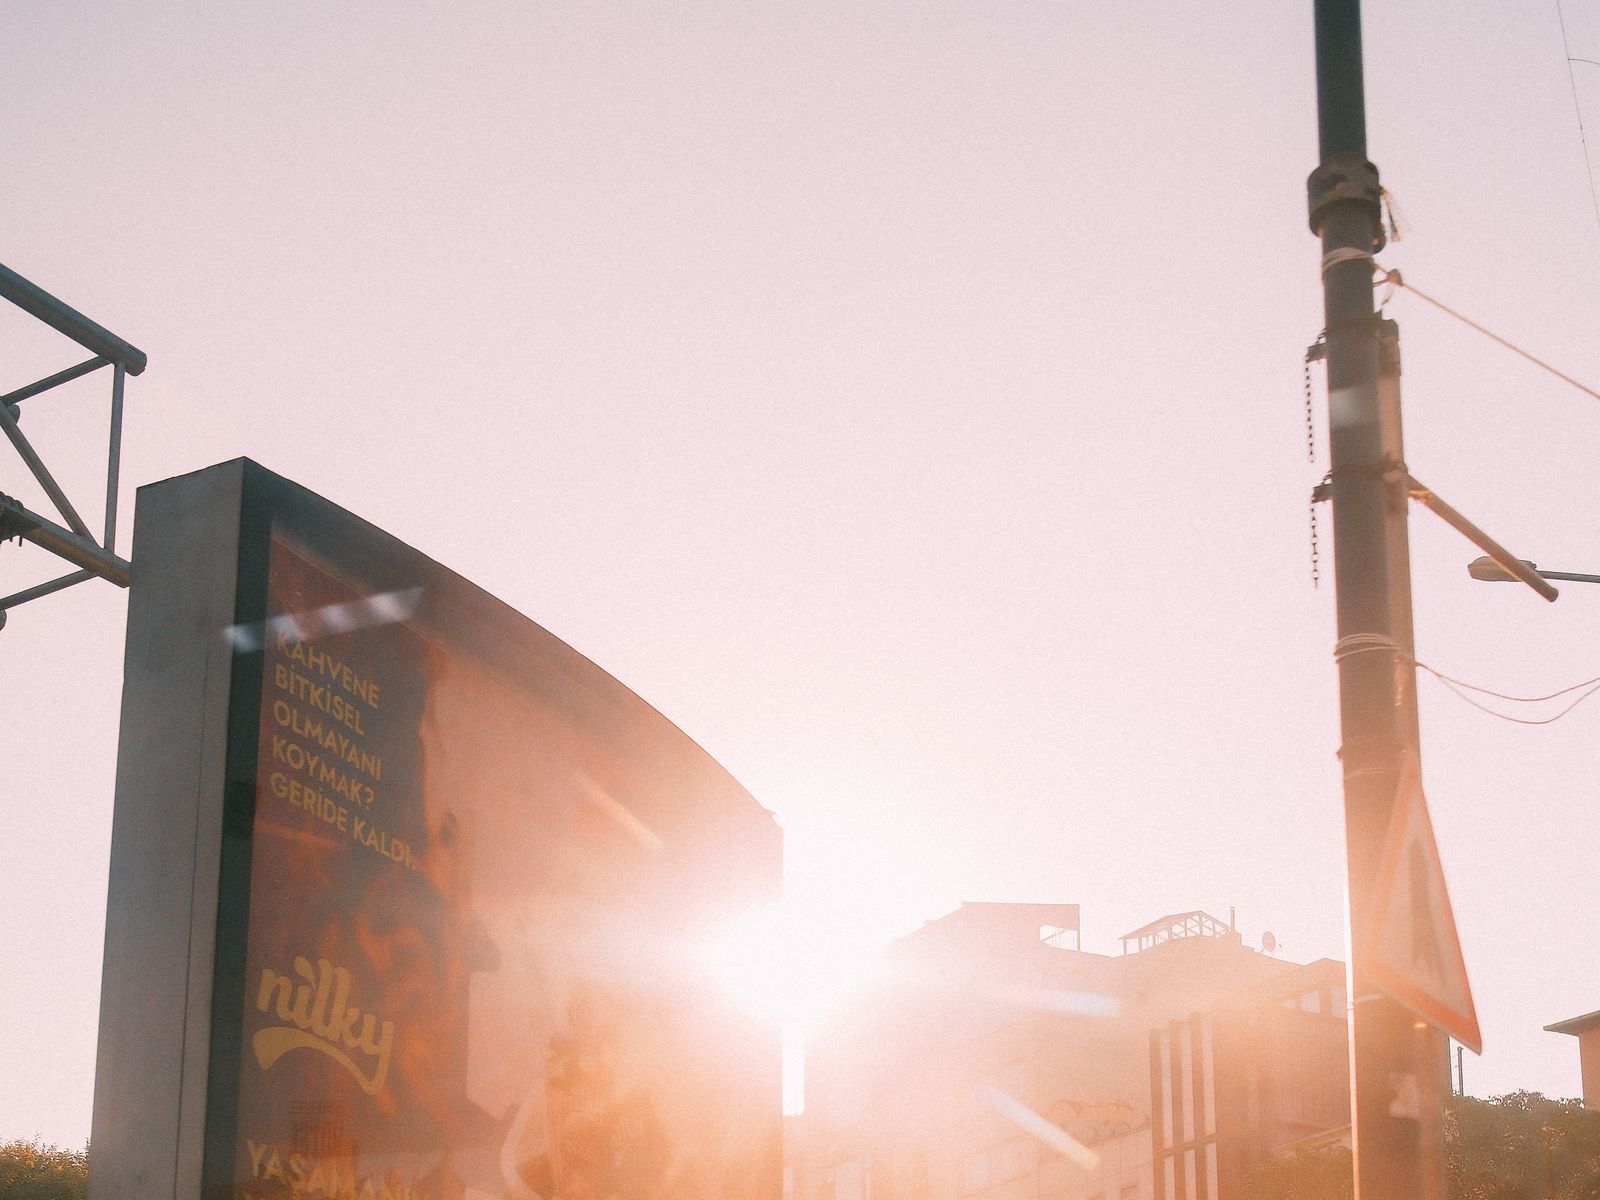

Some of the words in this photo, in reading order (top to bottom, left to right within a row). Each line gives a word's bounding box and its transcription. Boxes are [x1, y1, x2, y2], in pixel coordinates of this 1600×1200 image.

[274, 662, 364, 736] BİTKİSEL
[276, 633, 380, 710] KAHVENE
[271, 734, 375, 811] KOYMAK?
[273, 700, 381, 781] OLMAYANI
[269, 771, 347, 832] GERİDE
[353, 815, 417, 870] KALDI.
[256, 954, 394, 1096] nilky
